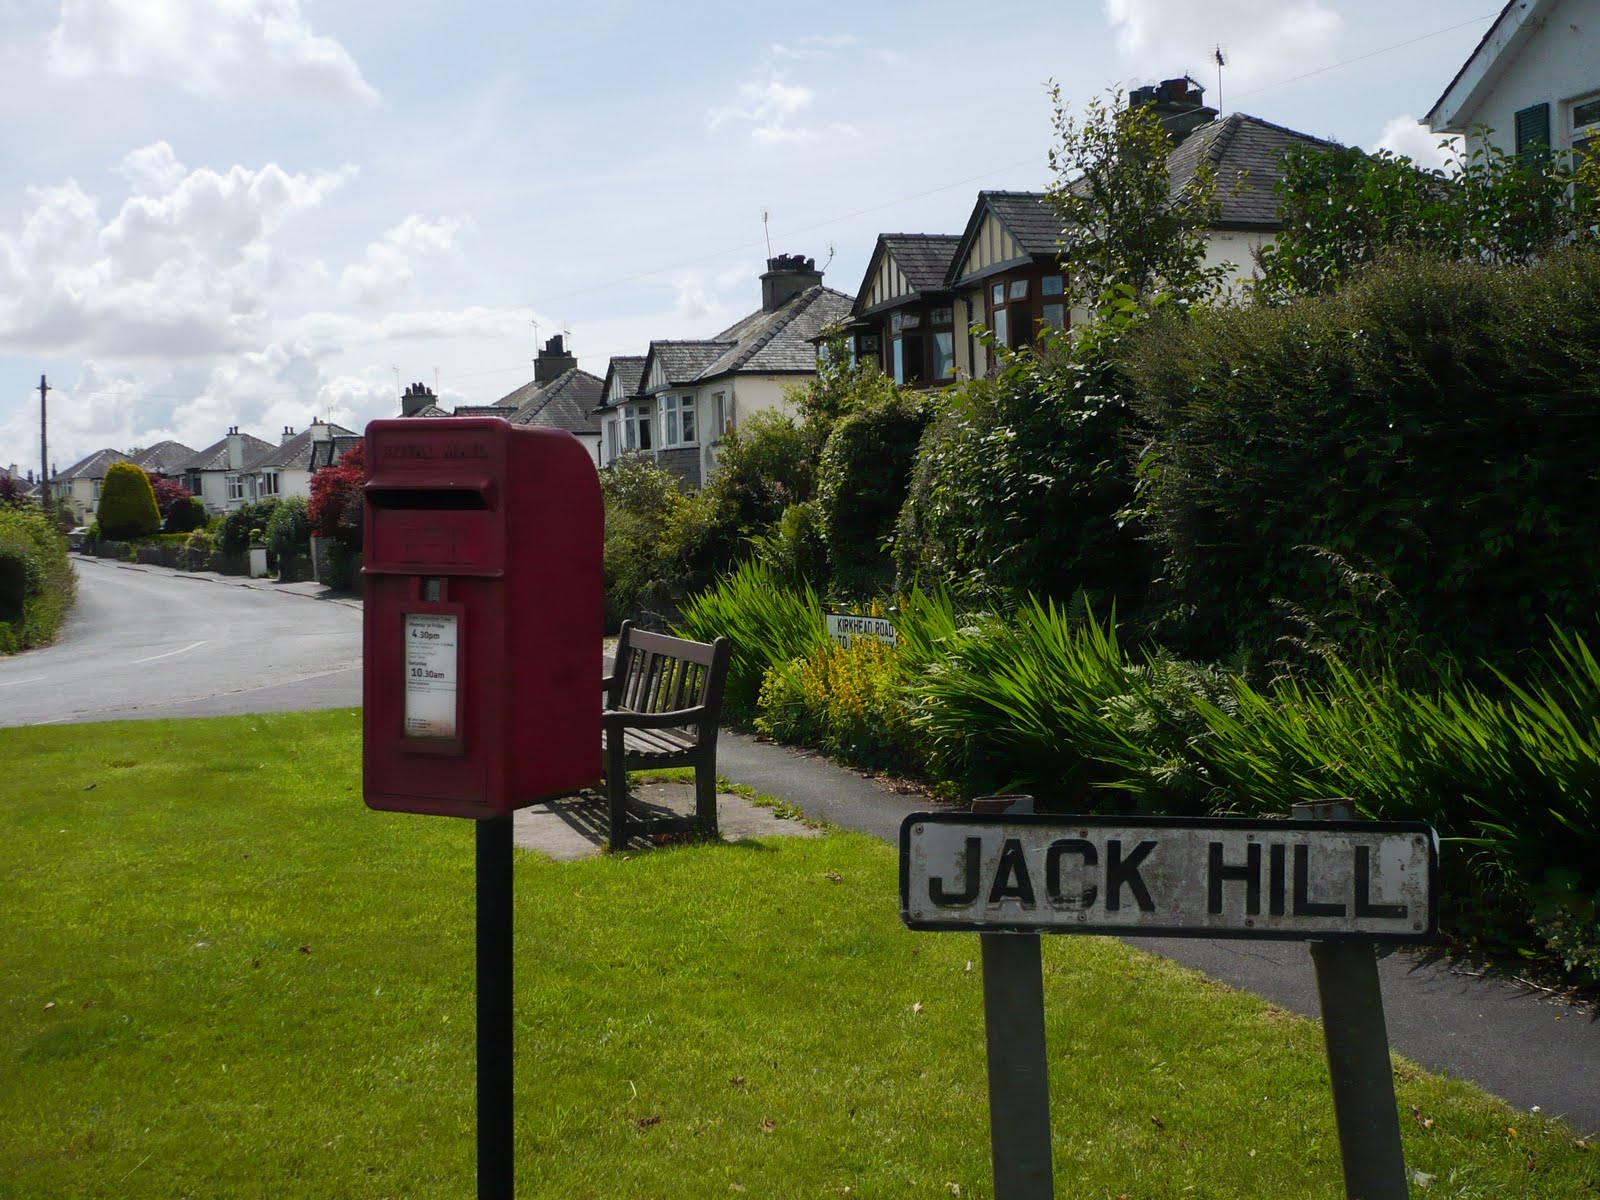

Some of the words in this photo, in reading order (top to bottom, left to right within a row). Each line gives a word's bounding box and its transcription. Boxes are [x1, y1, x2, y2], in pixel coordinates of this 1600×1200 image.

[412, 629, 440, 640] 4.30pm
[837, 618, 873, 635] KIRKHEAD
[876, 622, 894, 637] ROAD
[411, 668, 444, 678] 10.30am
[928, 837, 1158, 913] JACK
[1208, 842, 1409, 919] HILL
